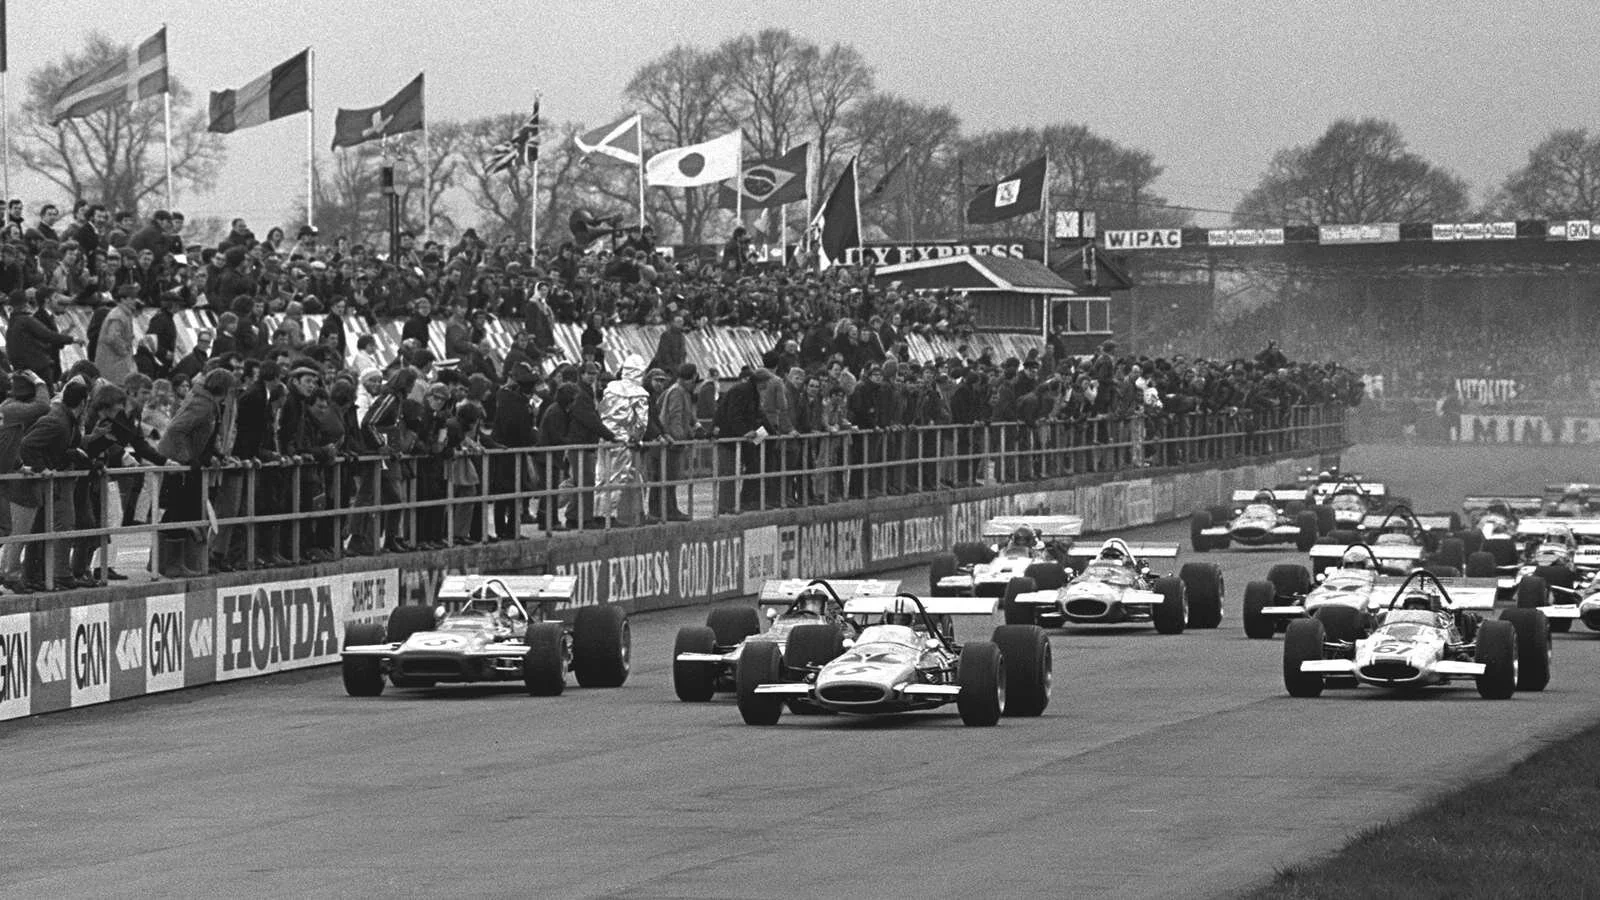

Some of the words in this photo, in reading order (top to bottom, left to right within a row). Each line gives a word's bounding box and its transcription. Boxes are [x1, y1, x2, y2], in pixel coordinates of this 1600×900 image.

[1108, 231, 1179, 247] WIPAC
[678, 542, 710, 599] GOLD
[711, 536, 741, 595] LEAF
[871, 520, 900, 562] DAILY
[903, 514, 944, 556] EXPRESS
[607, 550, 670, 603] EXPRESS
[75, 621, 108, 690] GKN
[149, 612, 183, 677] GKN
[222, 585, 338, 673] HONDA
